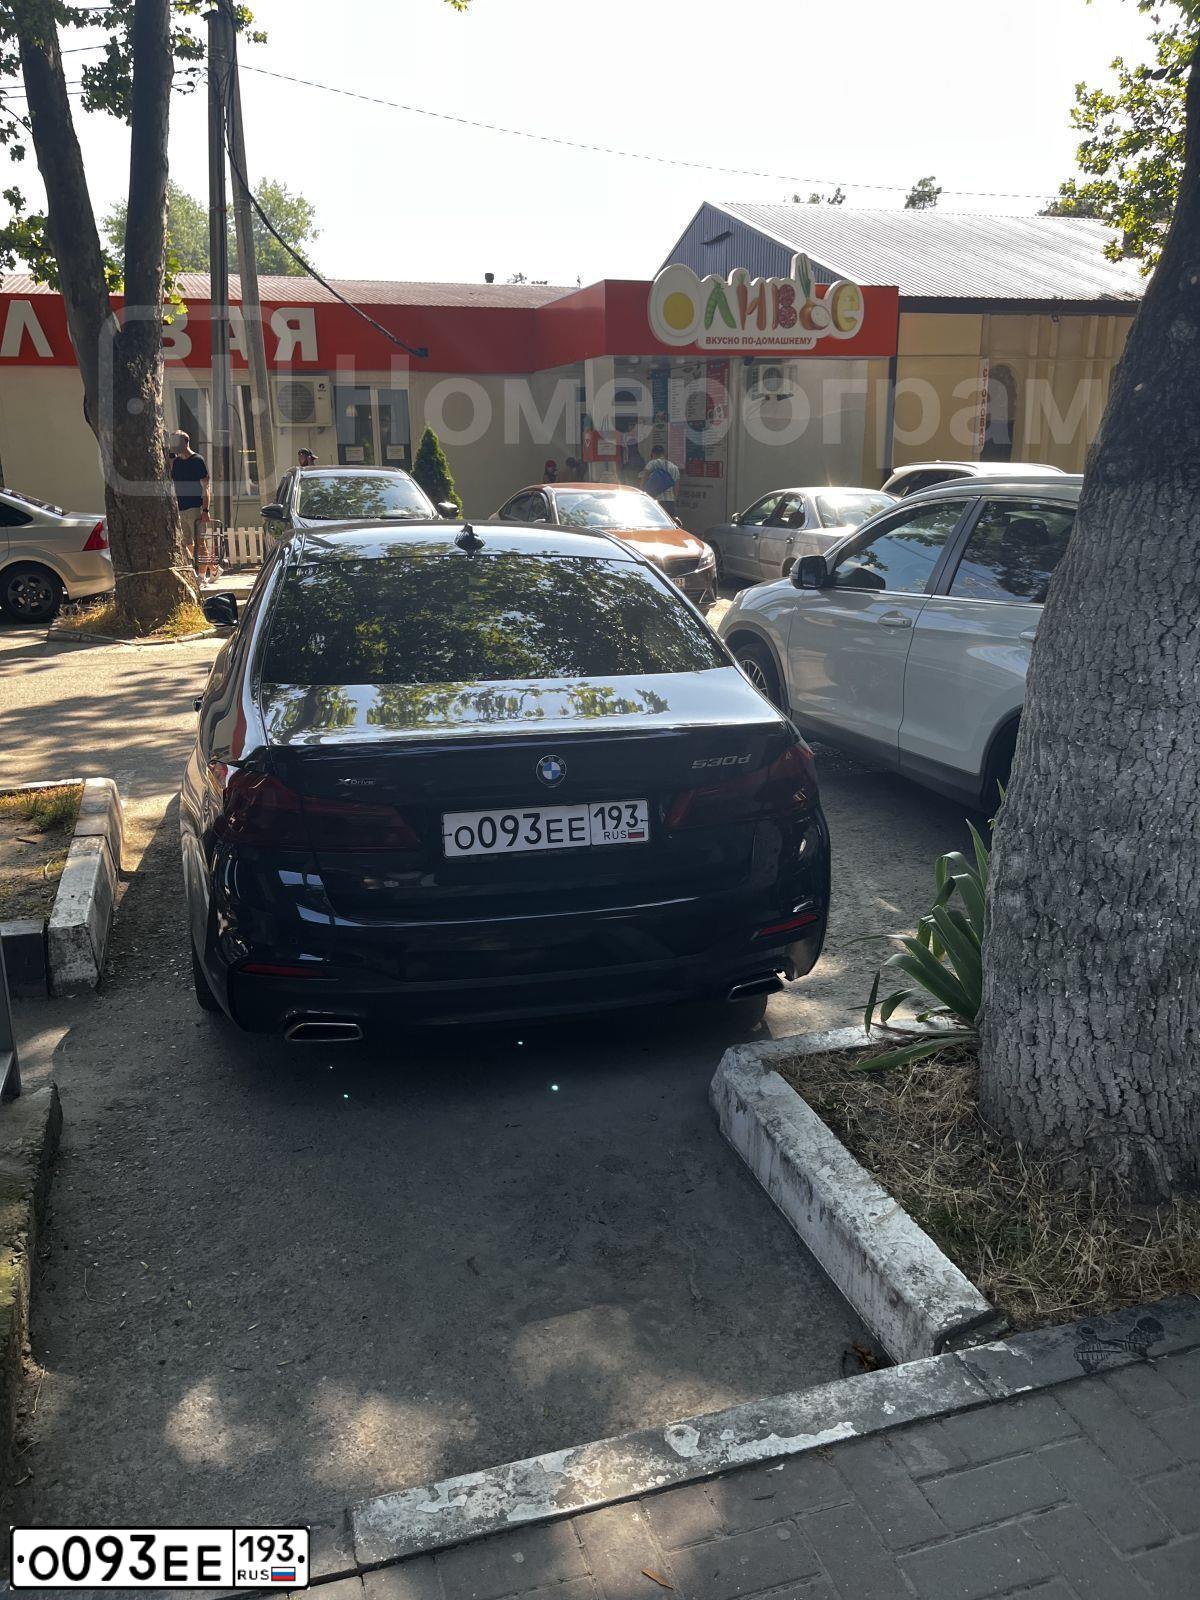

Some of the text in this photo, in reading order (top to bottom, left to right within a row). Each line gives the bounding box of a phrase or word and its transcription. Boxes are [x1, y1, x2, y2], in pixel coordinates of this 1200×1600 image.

[705, 336, 812, 346] ВКУСНО ПО-ДОМАШНЕМУ
[692, 753, 752, 769] 530d
[593, 804, 639, 830] 193
[604, 830, 628, 841] RUS
